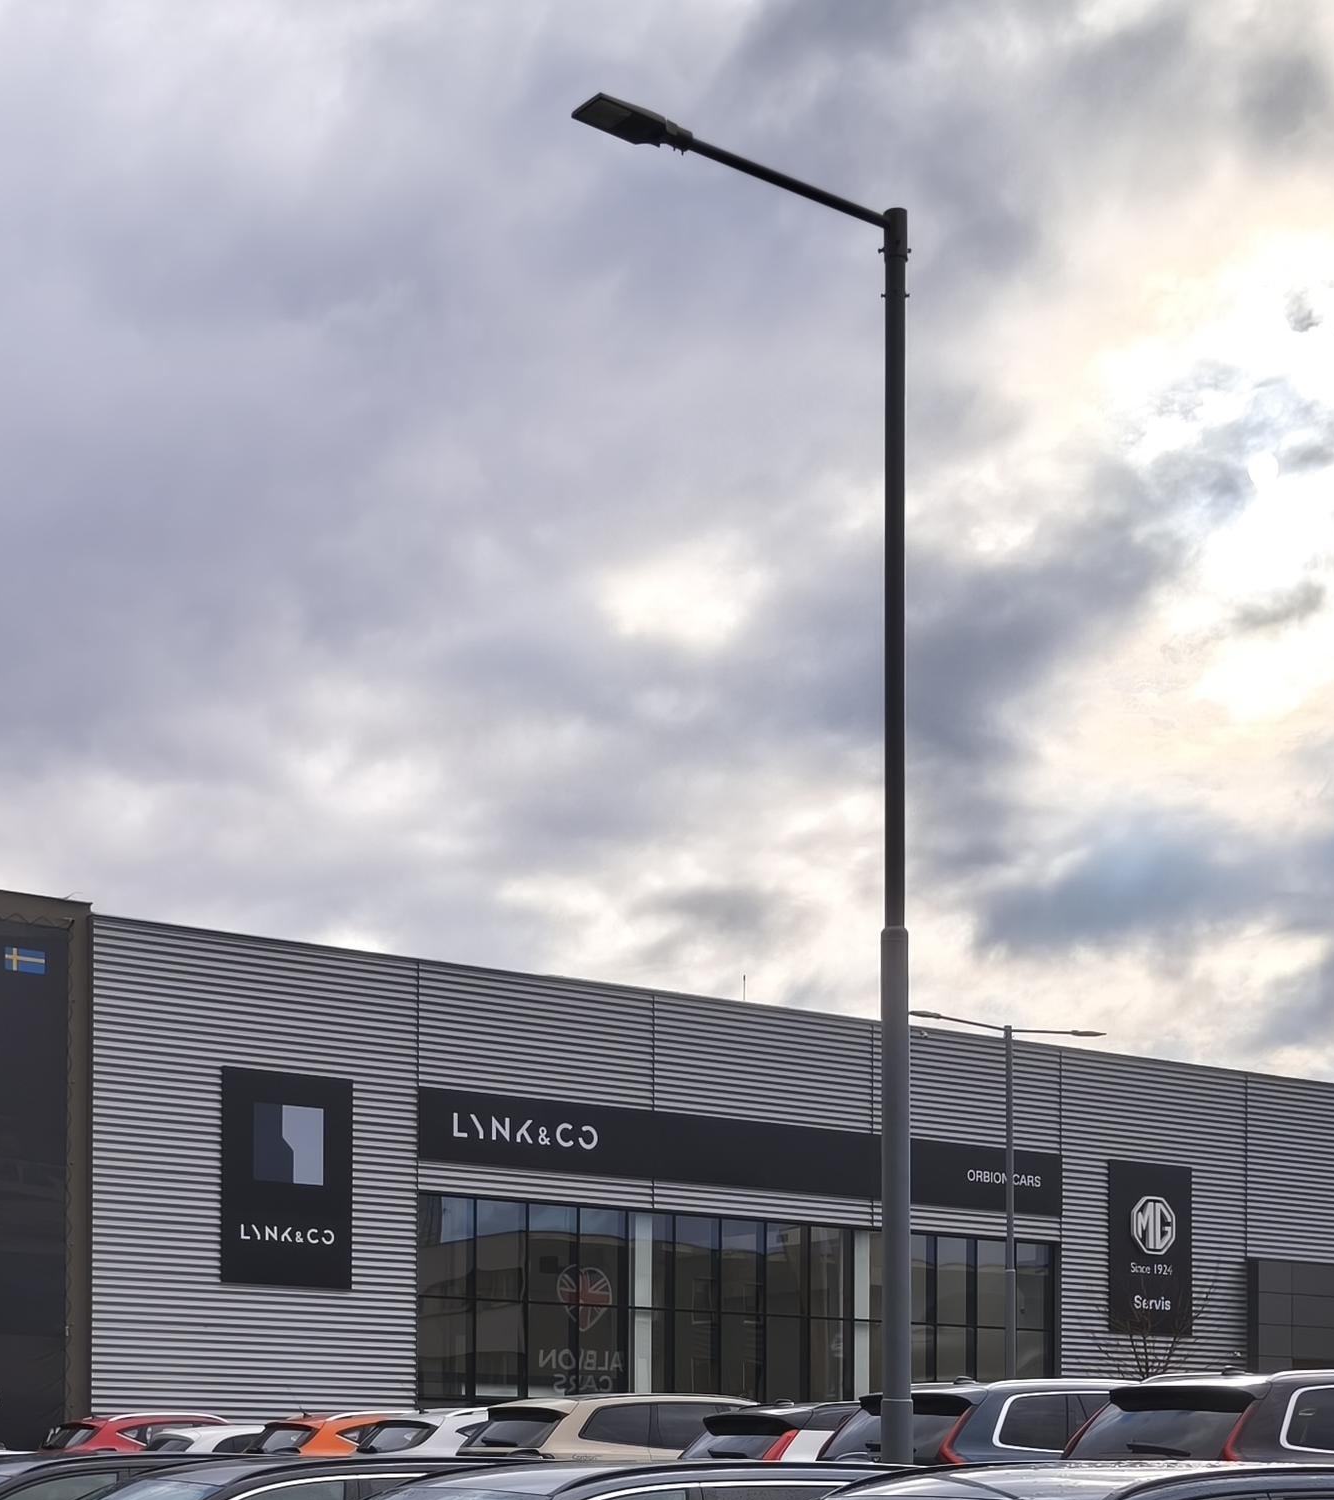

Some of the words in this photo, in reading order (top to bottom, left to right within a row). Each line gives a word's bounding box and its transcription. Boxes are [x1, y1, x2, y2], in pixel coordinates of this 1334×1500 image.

[453, 1112, 598, 1150] LYNK&CO
[1012, 1173, 1042, 1188] CARS
[240, 1223, 335, 1245] LYNK&CO
[1137, 1201, 1172, 1250] MG
[1130, 1262, 1151, 1274] Since
[1154, 1263, 1173, 1275] 1924
[1133, 1294, 1172, 1311] Servis
